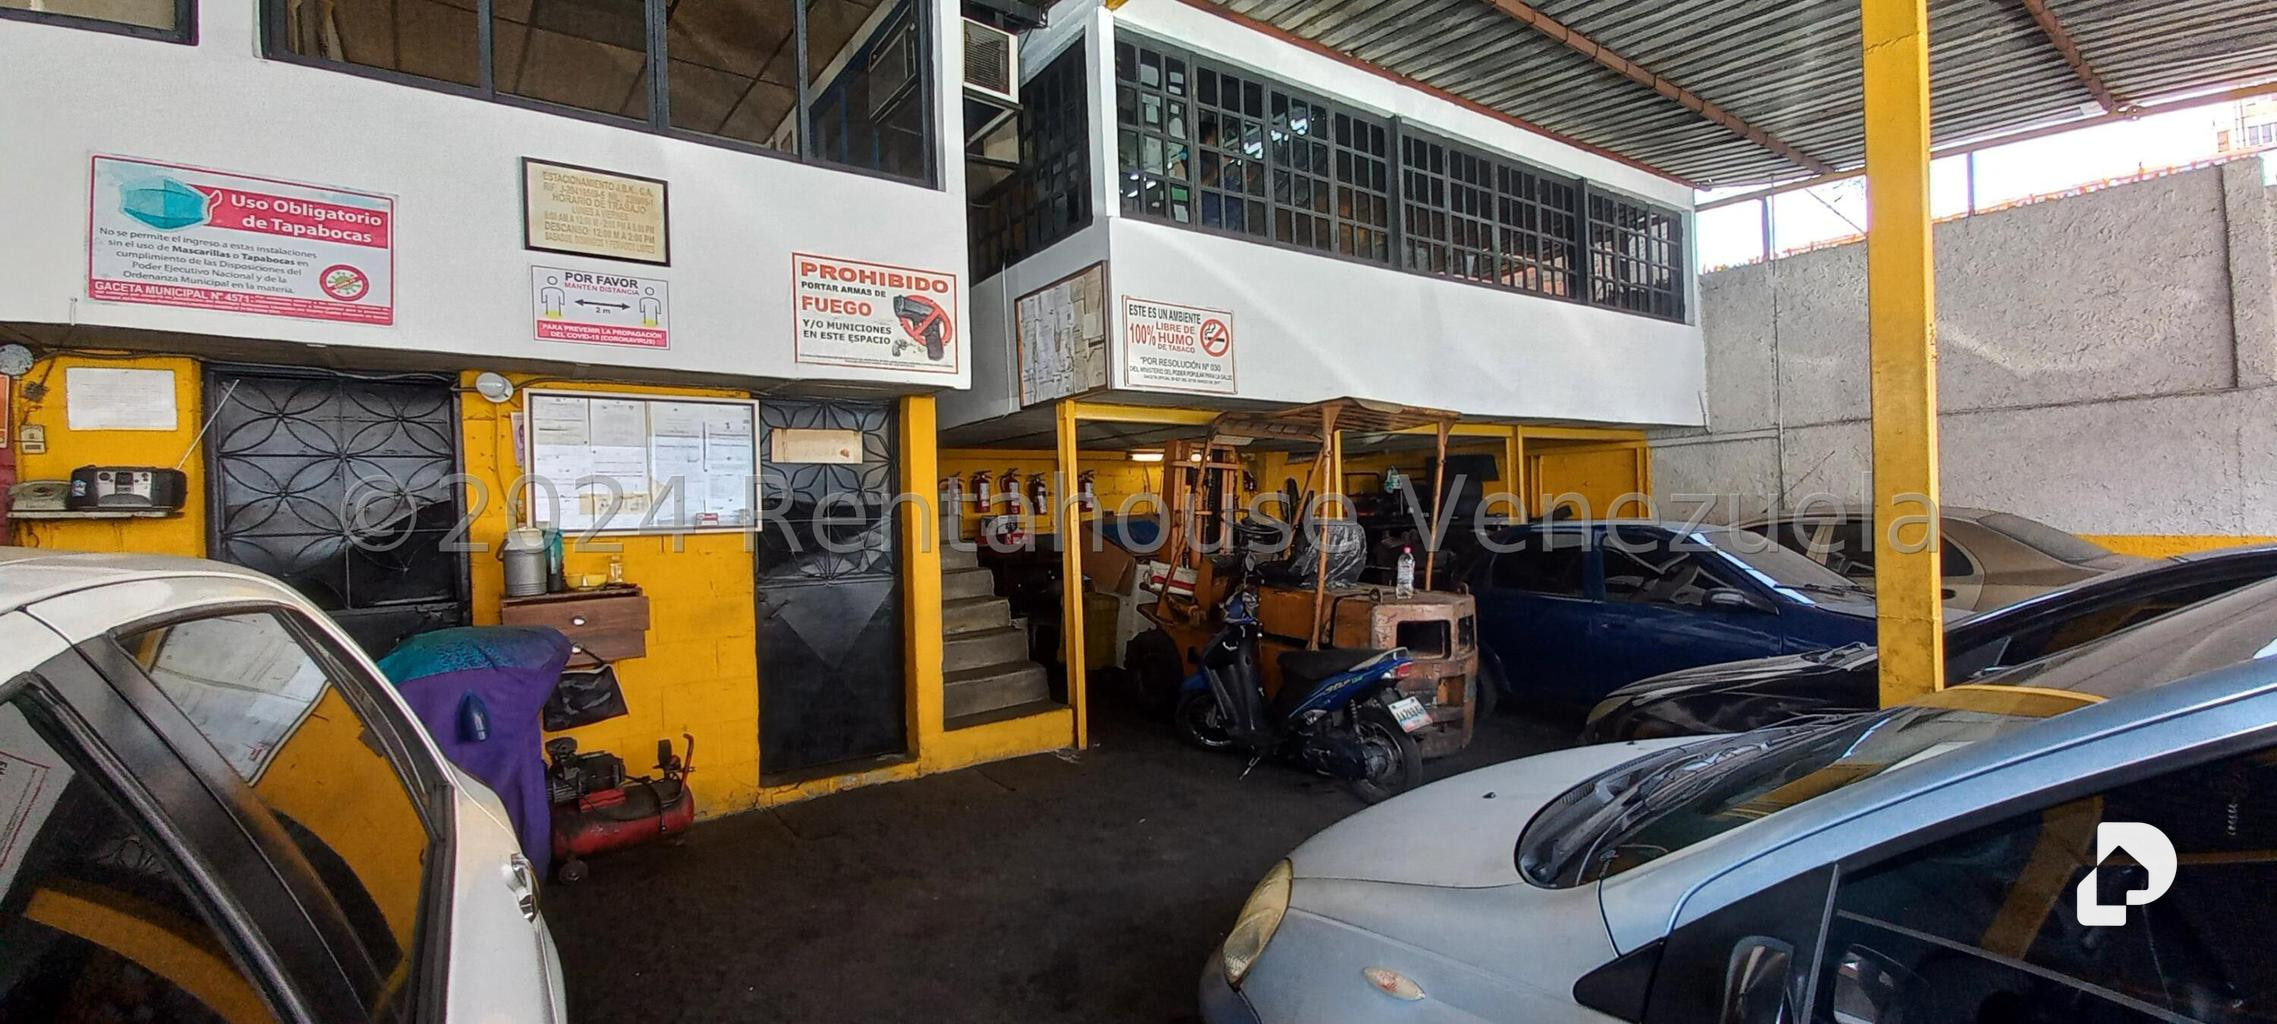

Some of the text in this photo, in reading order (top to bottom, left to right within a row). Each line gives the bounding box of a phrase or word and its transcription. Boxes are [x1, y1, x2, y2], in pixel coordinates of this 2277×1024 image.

[231, 194, 382, 226] Uso Obligatorio
[594, 199, 605, 208] DE
[242, 215, 372, 243] de Tapabocas
[100, 228, 114, 236] No
[130, 232, 169, 241] permite
[183, 237, 220, 247] ingreso
[230, 243, 254, 251] estas
[257, 246, 317, 259] instalaciones
[116, 251, 302, 276] cumplimiento de las Disposiciones del
[157, 244, 169, 252] de
[172, 246, 230, 259] Mascarillas
[242, 253, 295, 265] Tapabocas
[123, 270, 178, 282] Ordenanza
[181, 276, 229, 288] Municipal
[246, 282, 254, 290] la
[132, 261, 161, 270] Poder
[165, 265, 209, 276] Ejecutivo
[212, 270, 254, 280] Nacional
[264, 275, 276, 283] de
[565, 272, 638, 289] POR FAVOR
[801, 261, 949, 293] PROHIBIDO
[95, 281, 143, 293] GACETA
[146, 286, 208, 299] MUNICIPAL
[600, 286, 640, 296] DISTANCIA
[802, 281, 838, 292] PORTAR
[841, 286, 872, 296] ARMAS
[802, 295, 872, 316] FUEGO
[1129, 304, 1201, 324] ESTE ES UN AMBIENTE
[542, 323, 563, 331] PARA
[565, 326, 600, 335] PREVENIR
[602, 328, 612, 336] LA
[803, 319, 892, 335] Y/O MUNICIONES
[1130, 323, 1156, 346] 100%
[1156, 321, 1195, 335] LIBRE DE
[804, 330, 891, 345] EN ESTE ESPACIO
[1158, 332, 1194, 346] HUMO
[1169, 345, 1195, 353] TABACO
